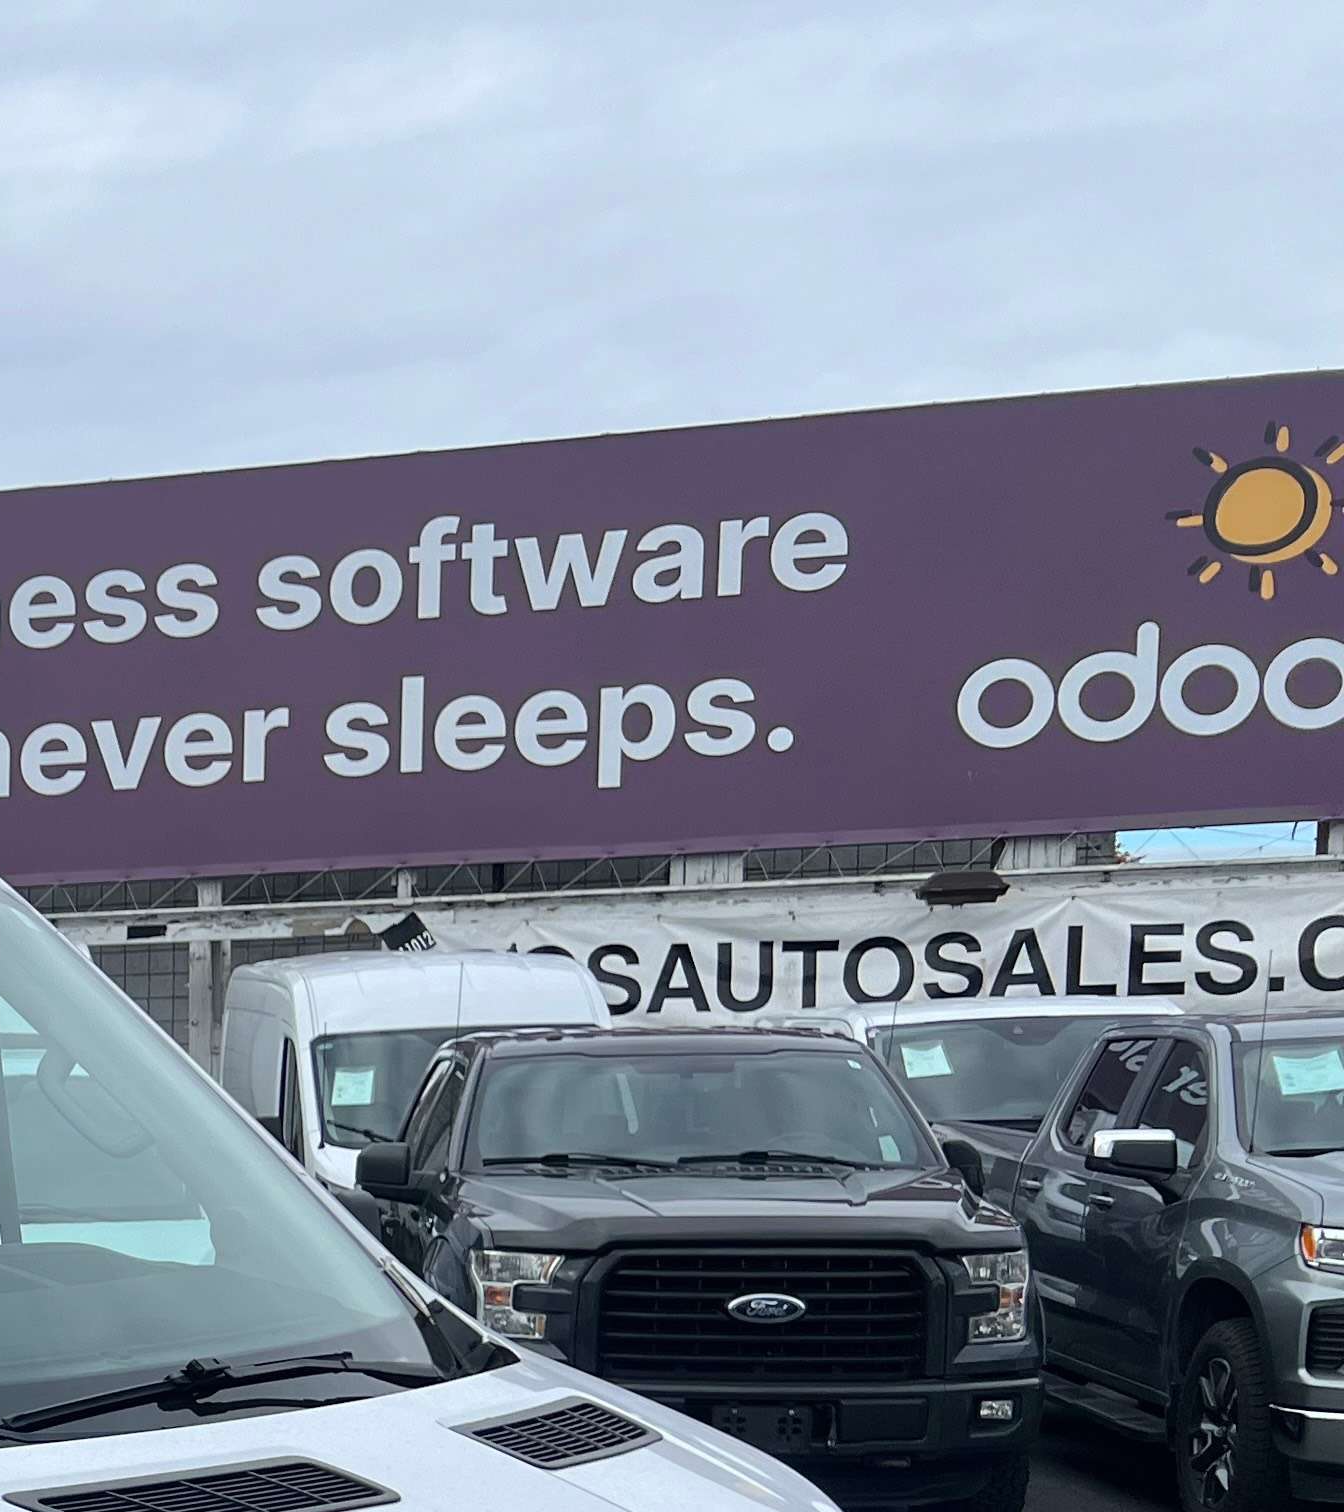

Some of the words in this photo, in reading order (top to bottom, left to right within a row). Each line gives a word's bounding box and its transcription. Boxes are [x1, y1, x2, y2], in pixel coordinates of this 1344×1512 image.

[255, 510, 850, 632] software
[323, 675, 795, 789] sleeps.
[956, 620, 1344, 749] odoo
